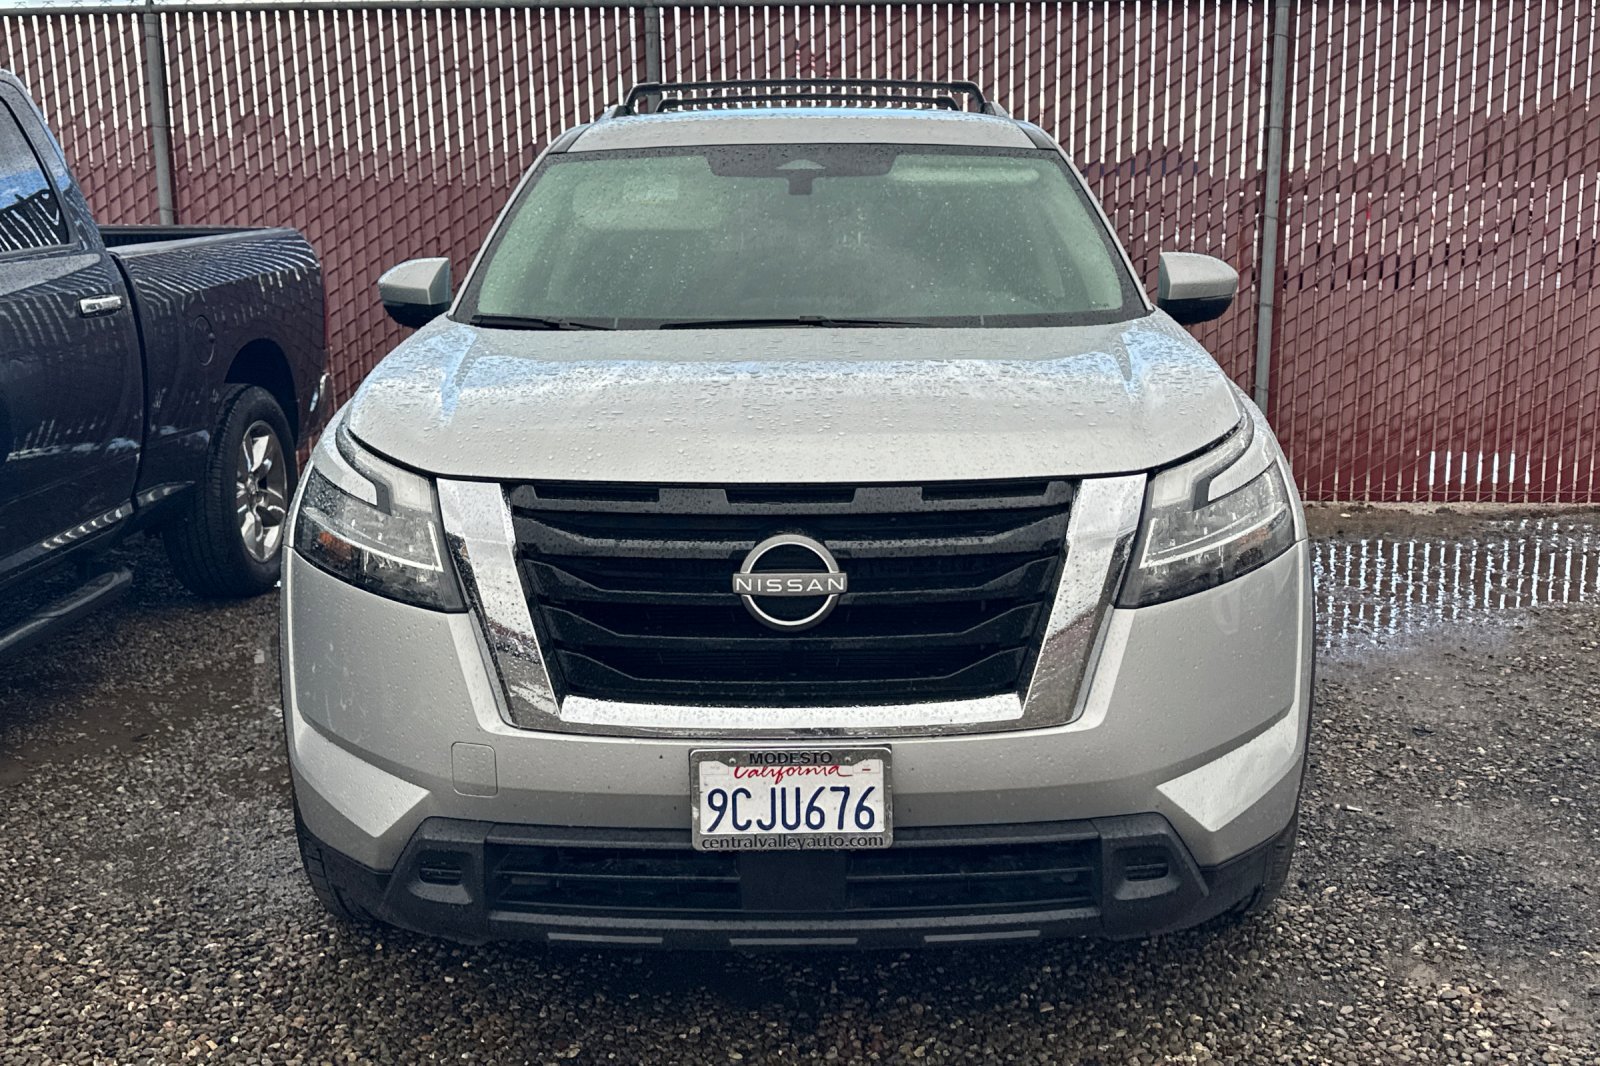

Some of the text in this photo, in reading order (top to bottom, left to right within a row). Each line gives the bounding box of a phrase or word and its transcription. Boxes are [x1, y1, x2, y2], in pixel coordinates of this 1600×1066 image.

[736, 577, 844, 592] NISSAN
[749, 751, 833, 765] MODESTO
[733, 764, 853, 785] California
[707, 786, 876, 832] 9CJU676
[701, 834, 884, 850] centralvalleyauto.com
